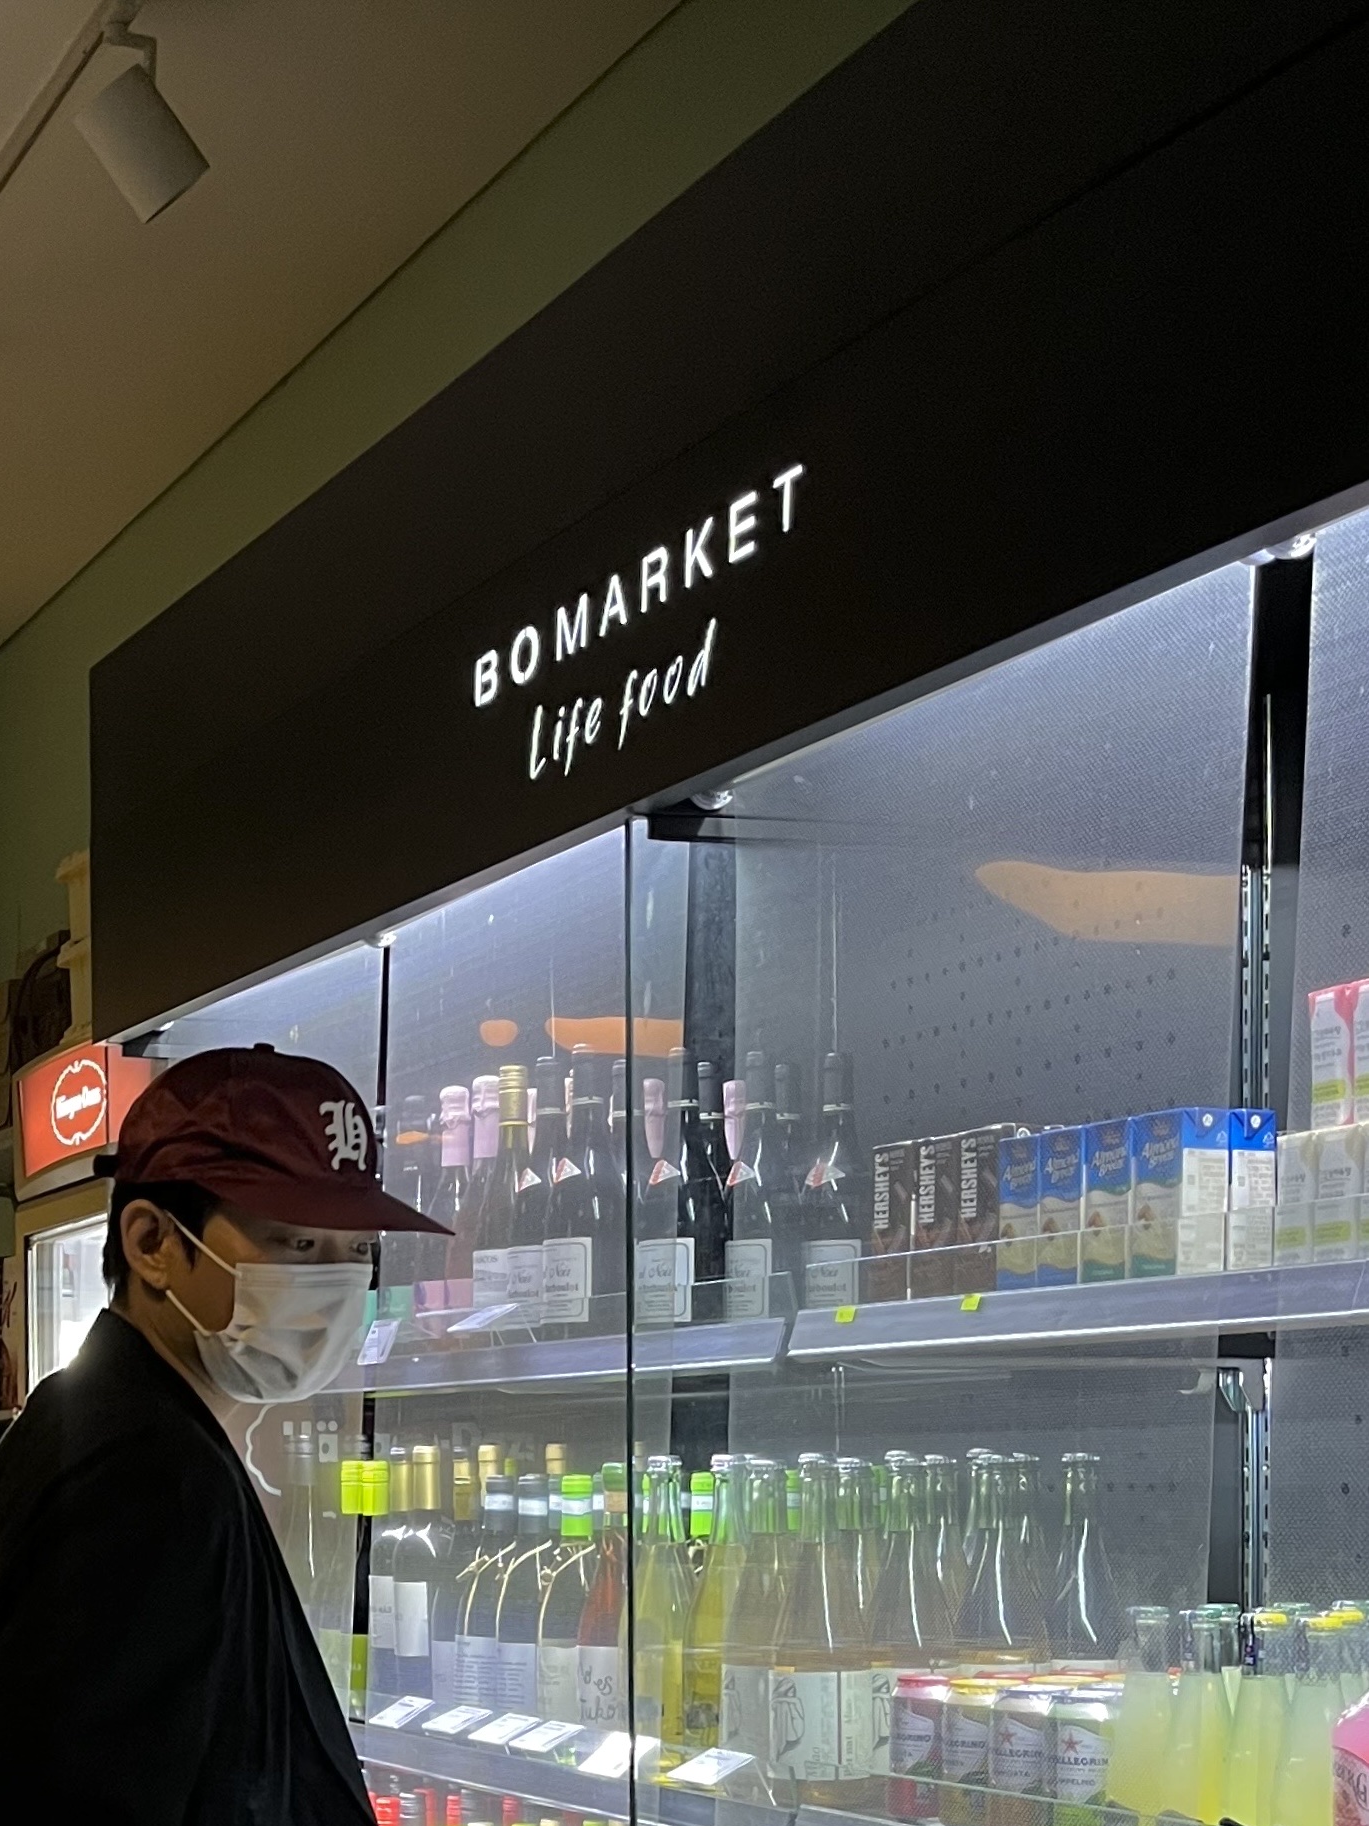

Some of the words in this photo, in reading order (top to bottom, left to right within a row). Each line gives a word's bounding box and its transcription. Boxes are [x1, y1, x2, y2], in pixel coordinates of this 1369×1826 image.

[473, 462, 807, 709] BOMARKET
[528, 697, 604, 781] Life
[617, 616, 719, 751] food
[873, 1152, 890, 1230] HERSHEY'S
[919, 1145, 936, 1224] HERSHEY'S
[961, 1138, 978, 1218] HERSHEY'S
